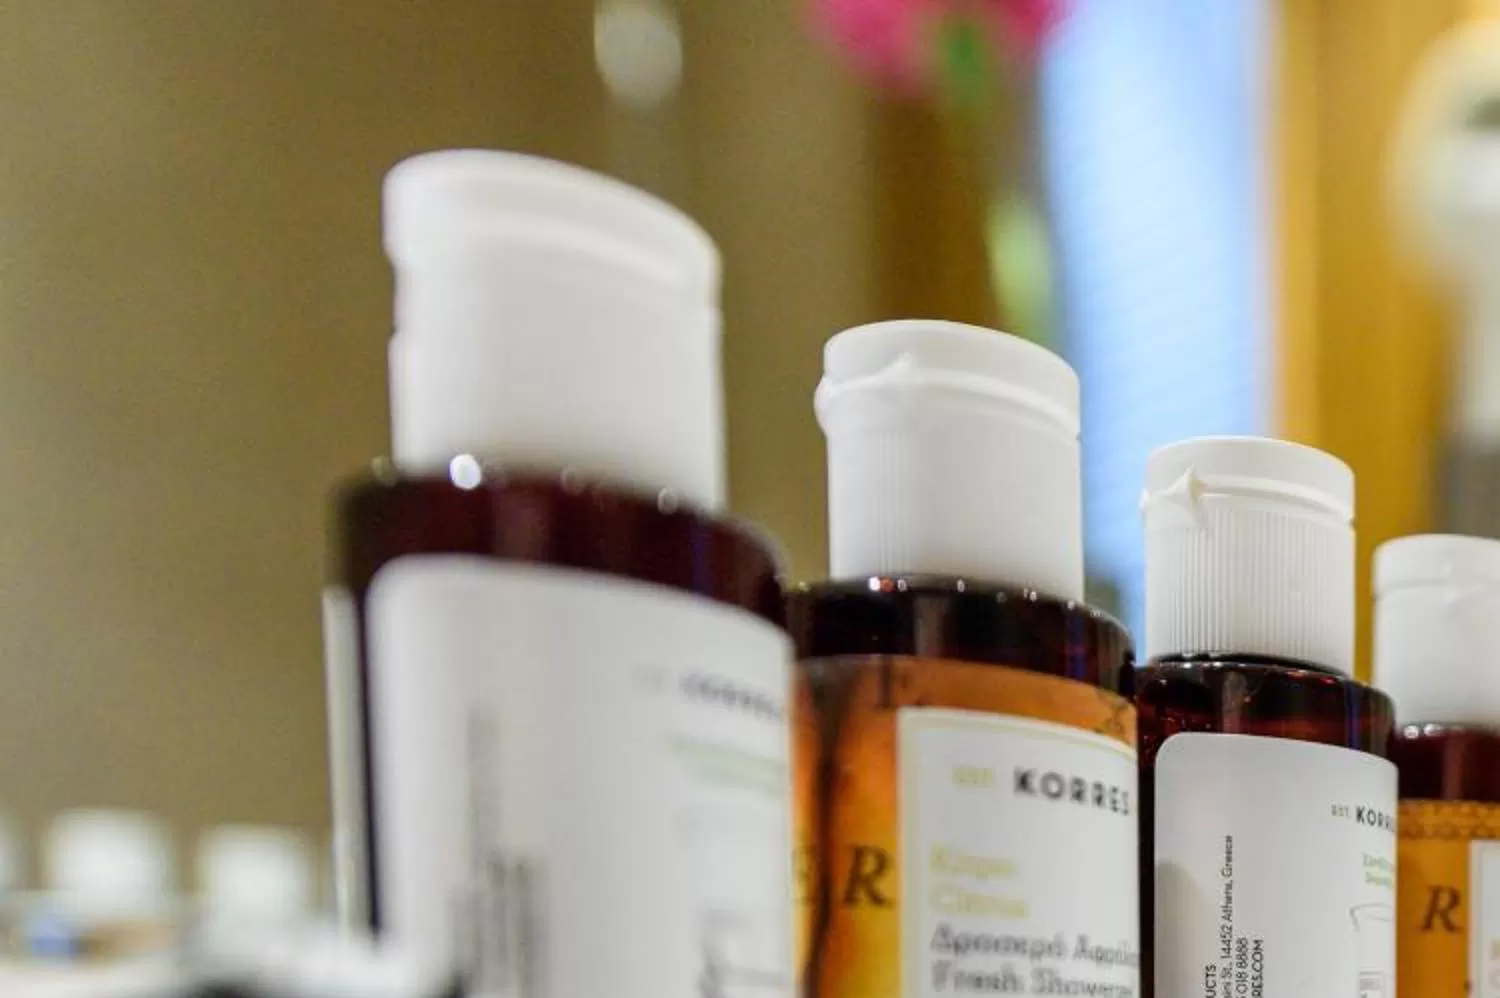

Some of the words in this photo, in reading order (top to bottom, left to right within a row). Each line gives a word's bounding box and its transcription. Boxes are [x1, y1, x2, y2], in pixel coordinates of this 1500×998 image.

[1013, 766, 1130, 816] KORRES
[1220, 836, 1233, 878] Greece
[1220, 880, 1234, 922] Athens,
[1220, 924, 1233, 959] 14452
[1236, 937, 1249, 969] 8888
[1236, 972, 1248, 994] 018
